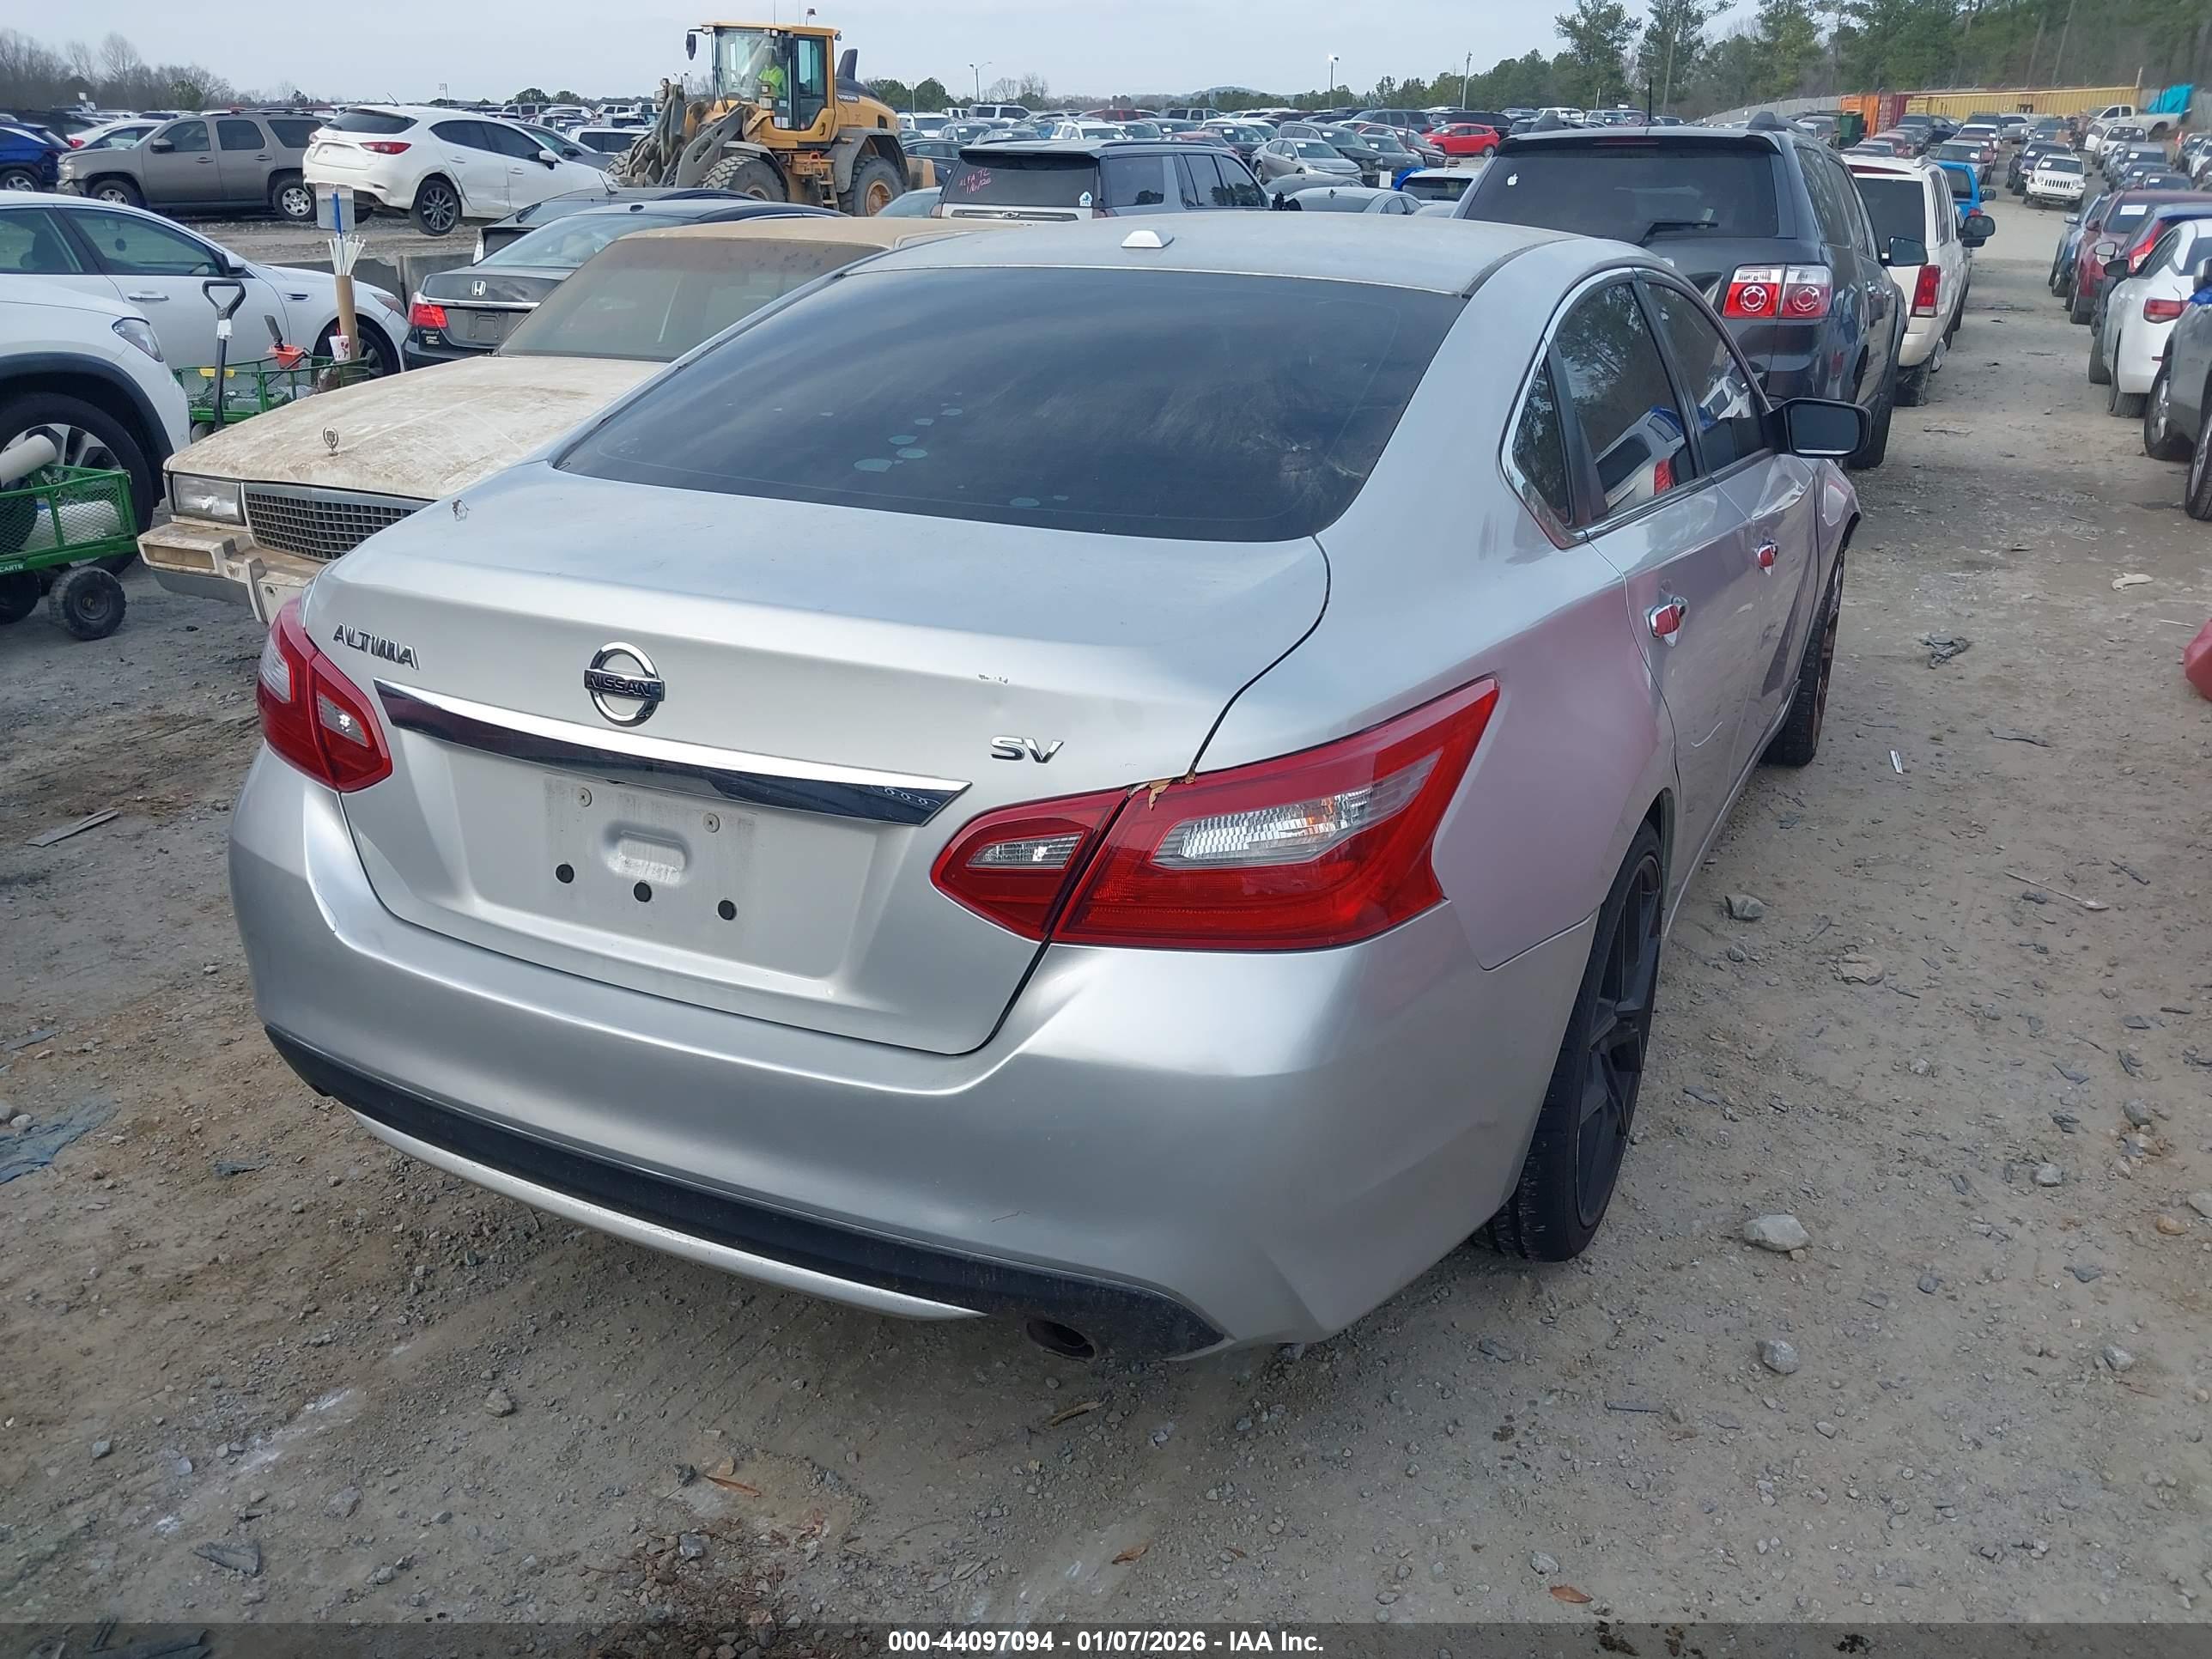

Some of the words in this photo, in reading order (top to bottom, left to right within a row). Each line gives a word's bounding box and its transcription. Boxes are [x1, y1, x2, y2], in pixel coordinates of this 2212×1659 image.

[332, 623, 420, 671] ALTIMA
[589, 673, 653, 696] NISSAN
[990, 735, 1065, 764] SV
